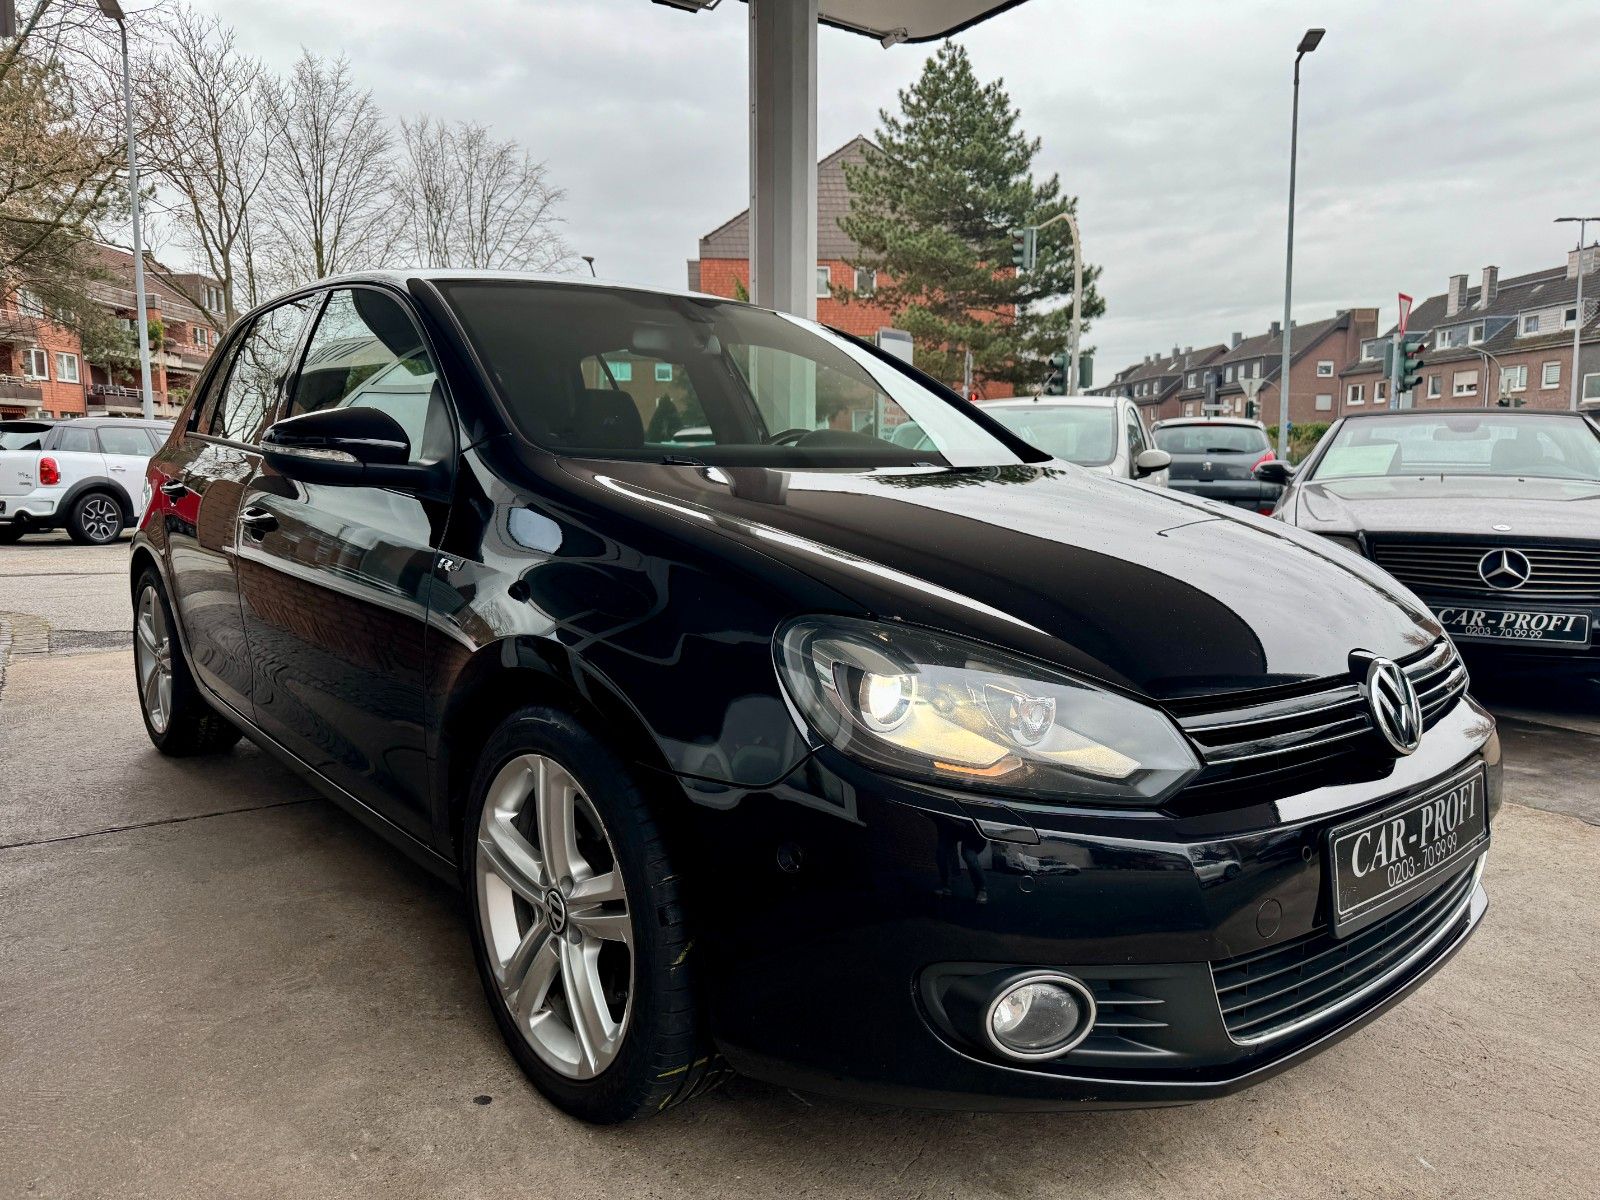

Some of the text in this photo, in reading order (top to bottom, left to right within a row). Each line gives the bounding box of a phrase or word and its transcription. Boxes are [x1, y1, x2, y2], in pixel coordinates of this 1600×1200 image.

[1465, 626, 1491, 636] 0203
[1500, 627, 1513, 637] 70
[1514, 629, 1528, 638] 99
[1529, 630, 1543, 639] 99
[1351, 779, 1477, 878] CAR-PROFI
[1387, 856, 1415, 888] 0203
[1422, 846, 1436, 871] 70
[1436, 839, 1447, 861] 99
[1447, 831, 1458, 855] 99
